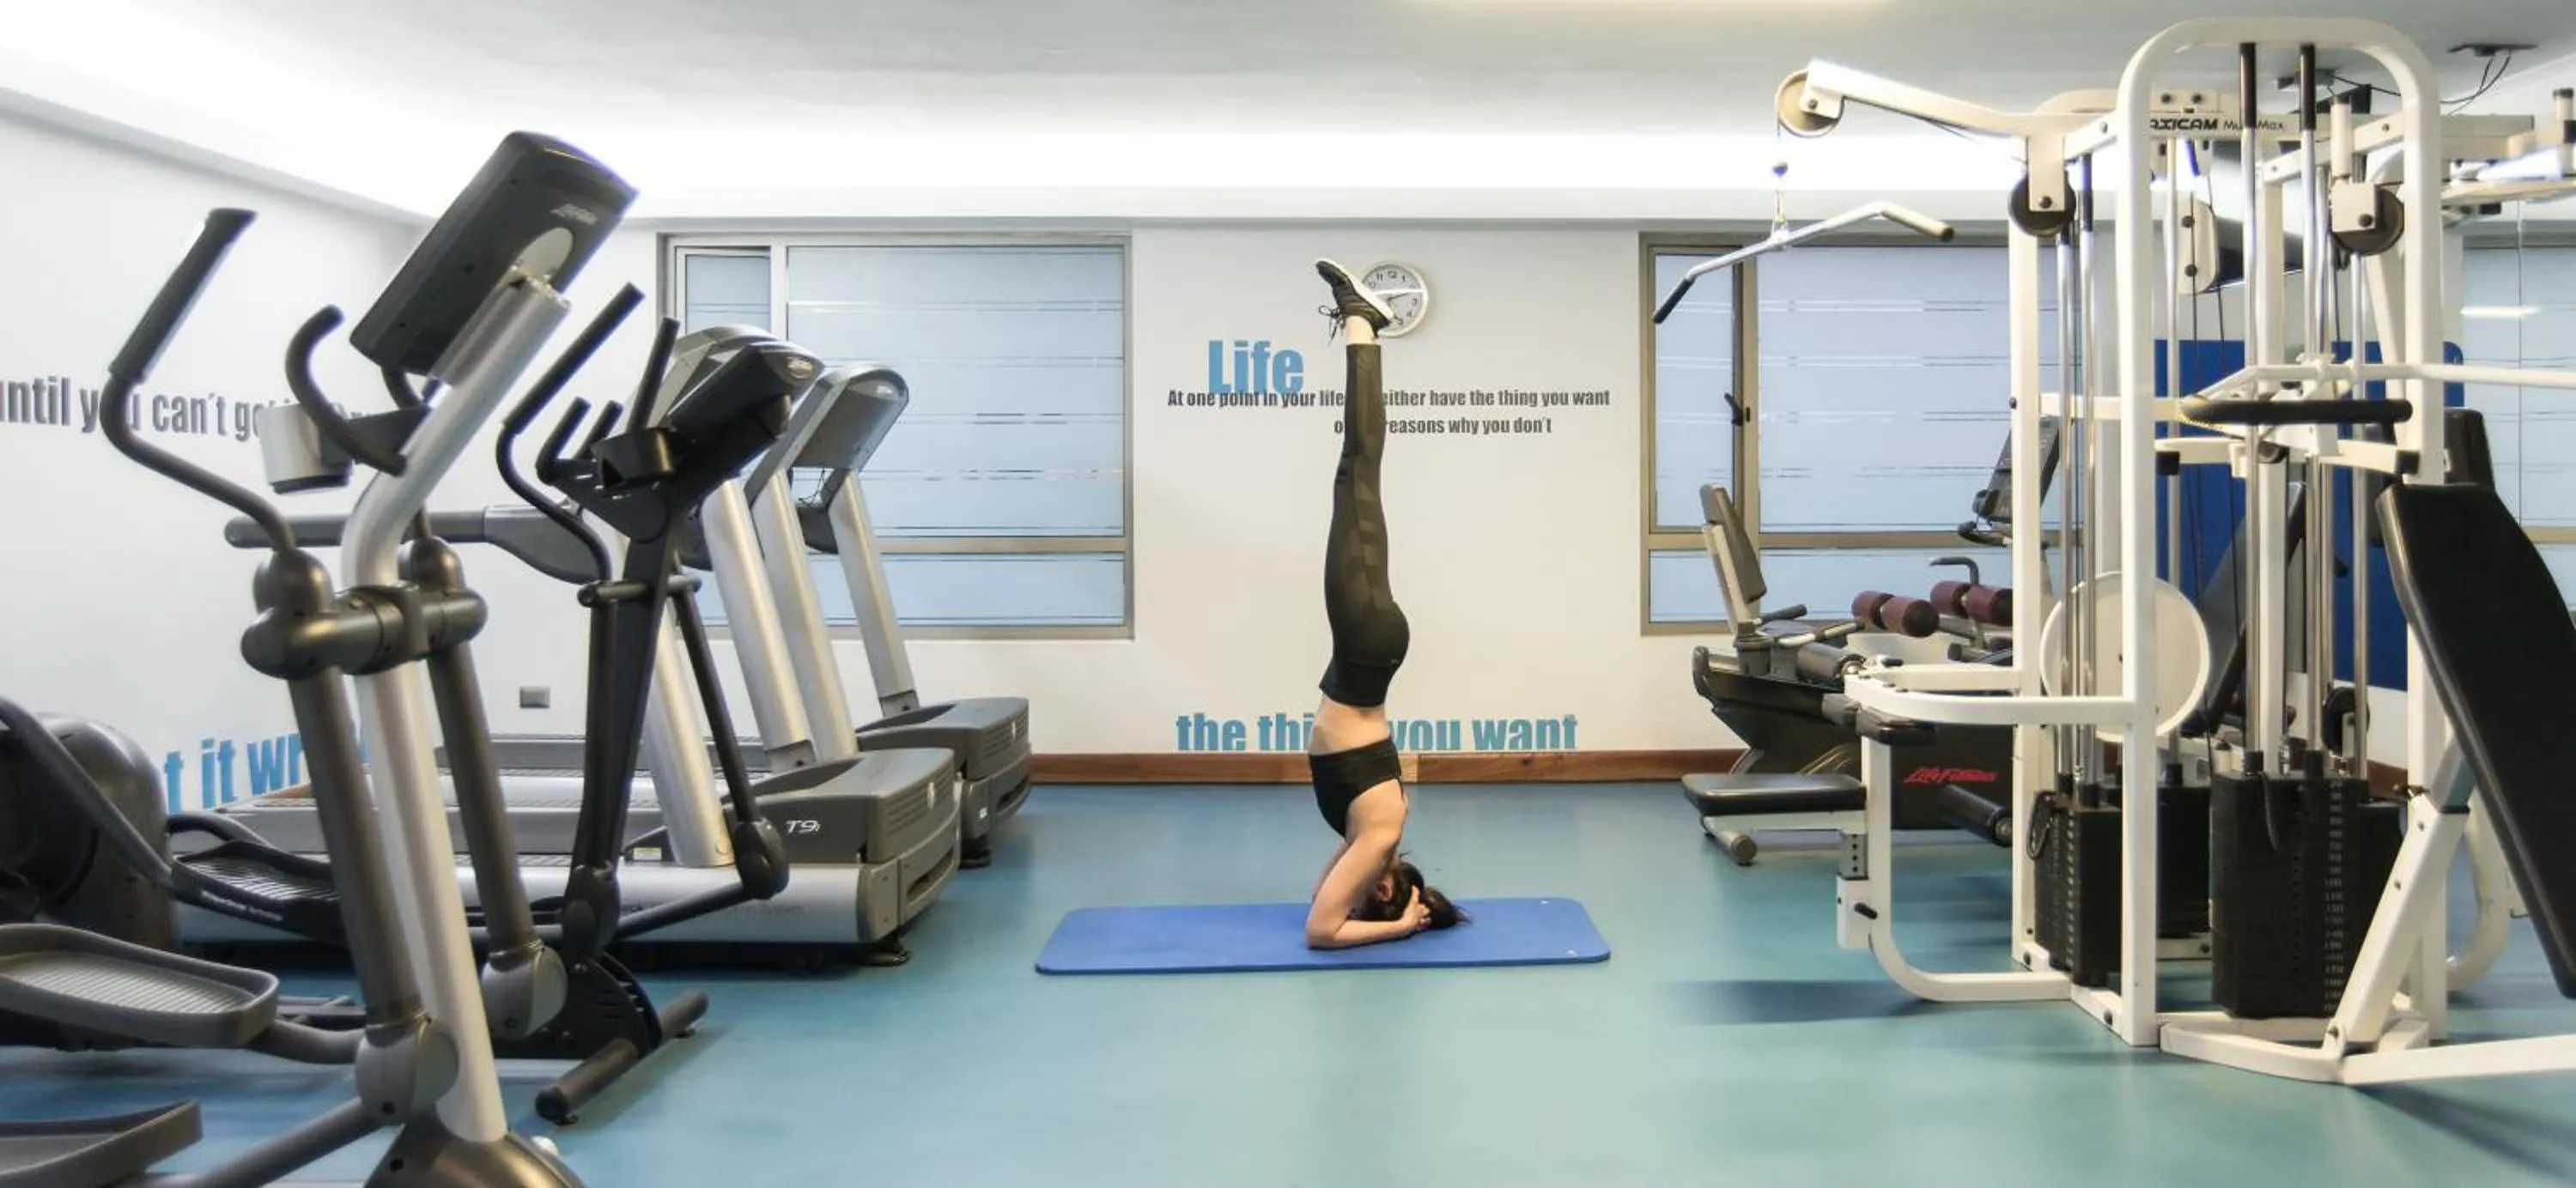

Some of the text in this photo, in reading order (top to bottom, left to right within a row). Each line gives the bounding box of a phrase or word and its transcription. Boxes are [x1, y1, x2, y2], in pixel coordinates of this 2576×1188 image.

[2149, 118, 2218, 130] AXICAM
[1208, 340, 1304, 396] Life
[0, 376, 71, 427] ntil
[80, 389, 141, 433] yu
[1168, 391, 1183, 407] At
[1187, 393, 1216, 407] one
[1219, 391, 1260, 409] point
[1263, 391, 1279, 407] in
[1282, 392, 1316, 409] your
[1320, 391, 1345, 407] life
[1430, 390, 1466, 406] have
[1469, 390, 1495, 406] the
[1498, 390, 1538, 408] thing
[1541, 392, 1569, 408] you
[1572, 391, 1611, 406] want
[1385, 420, 1445, 433] easons
[1449, 417, 1479, 435] why
[1482, 420, 1510, 435] you
[1176, 713, 1246, 750] the
[1257, 713, 1315, 751] thi
[1472, 715, 1578, 750] want
[201, 738, 236, 809] it
